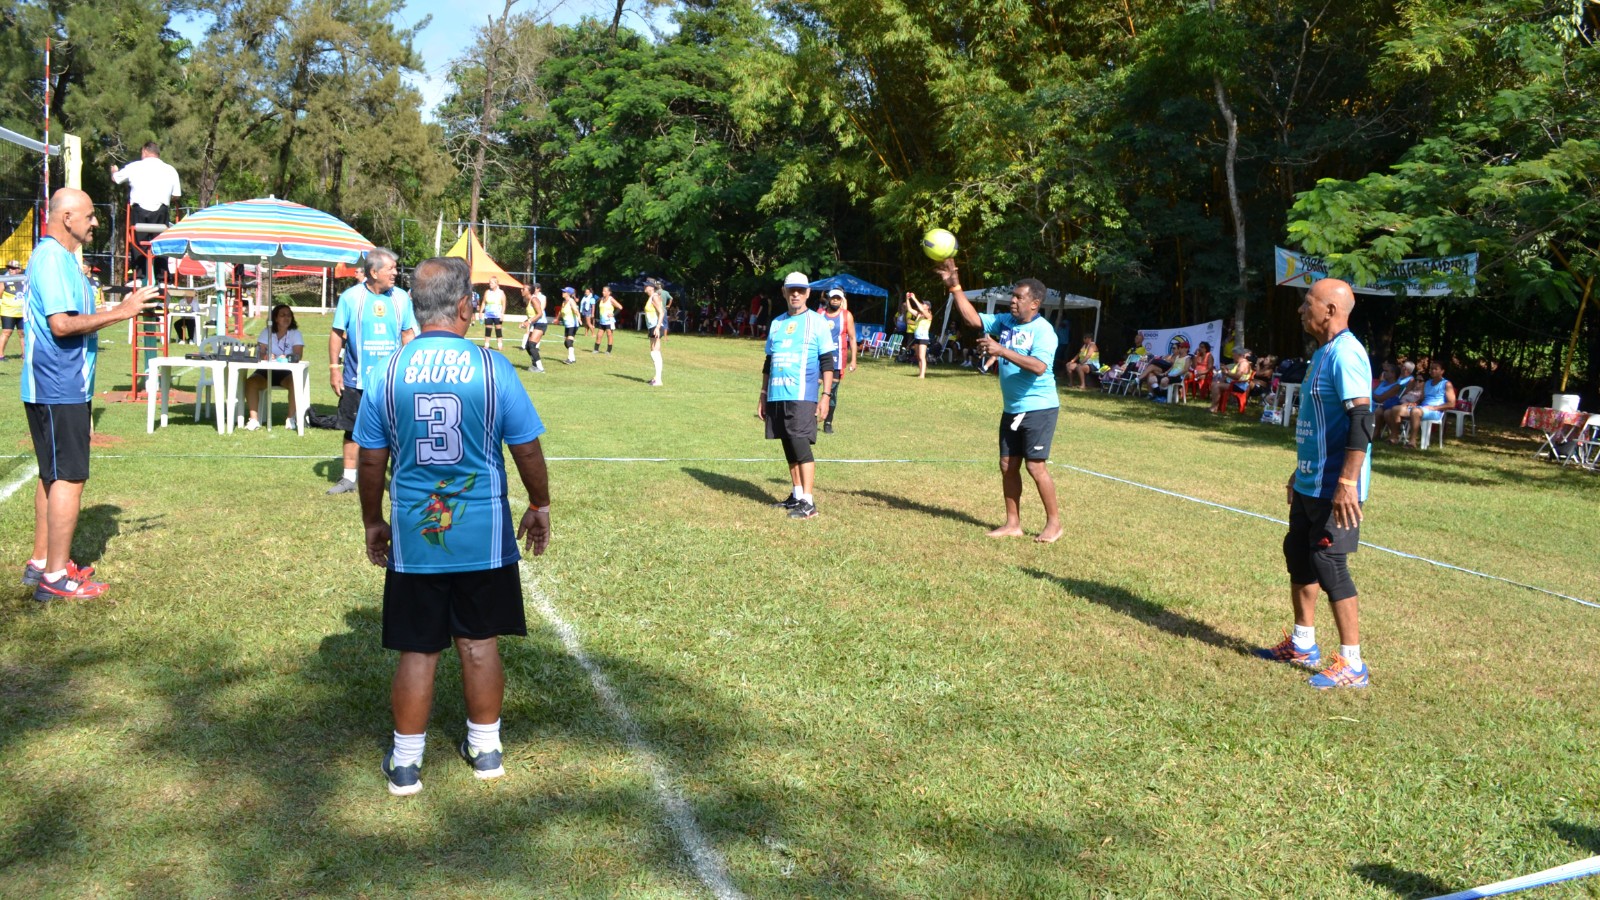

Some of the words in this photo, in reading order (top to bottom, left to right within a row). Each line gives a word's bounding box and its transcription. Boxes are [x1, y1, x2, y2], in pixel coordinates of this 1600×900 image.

[409, 349, 471, 366] ATIBA
[404, 365, 476, 384] BAURU
[414, 393, 464, 466] 3
